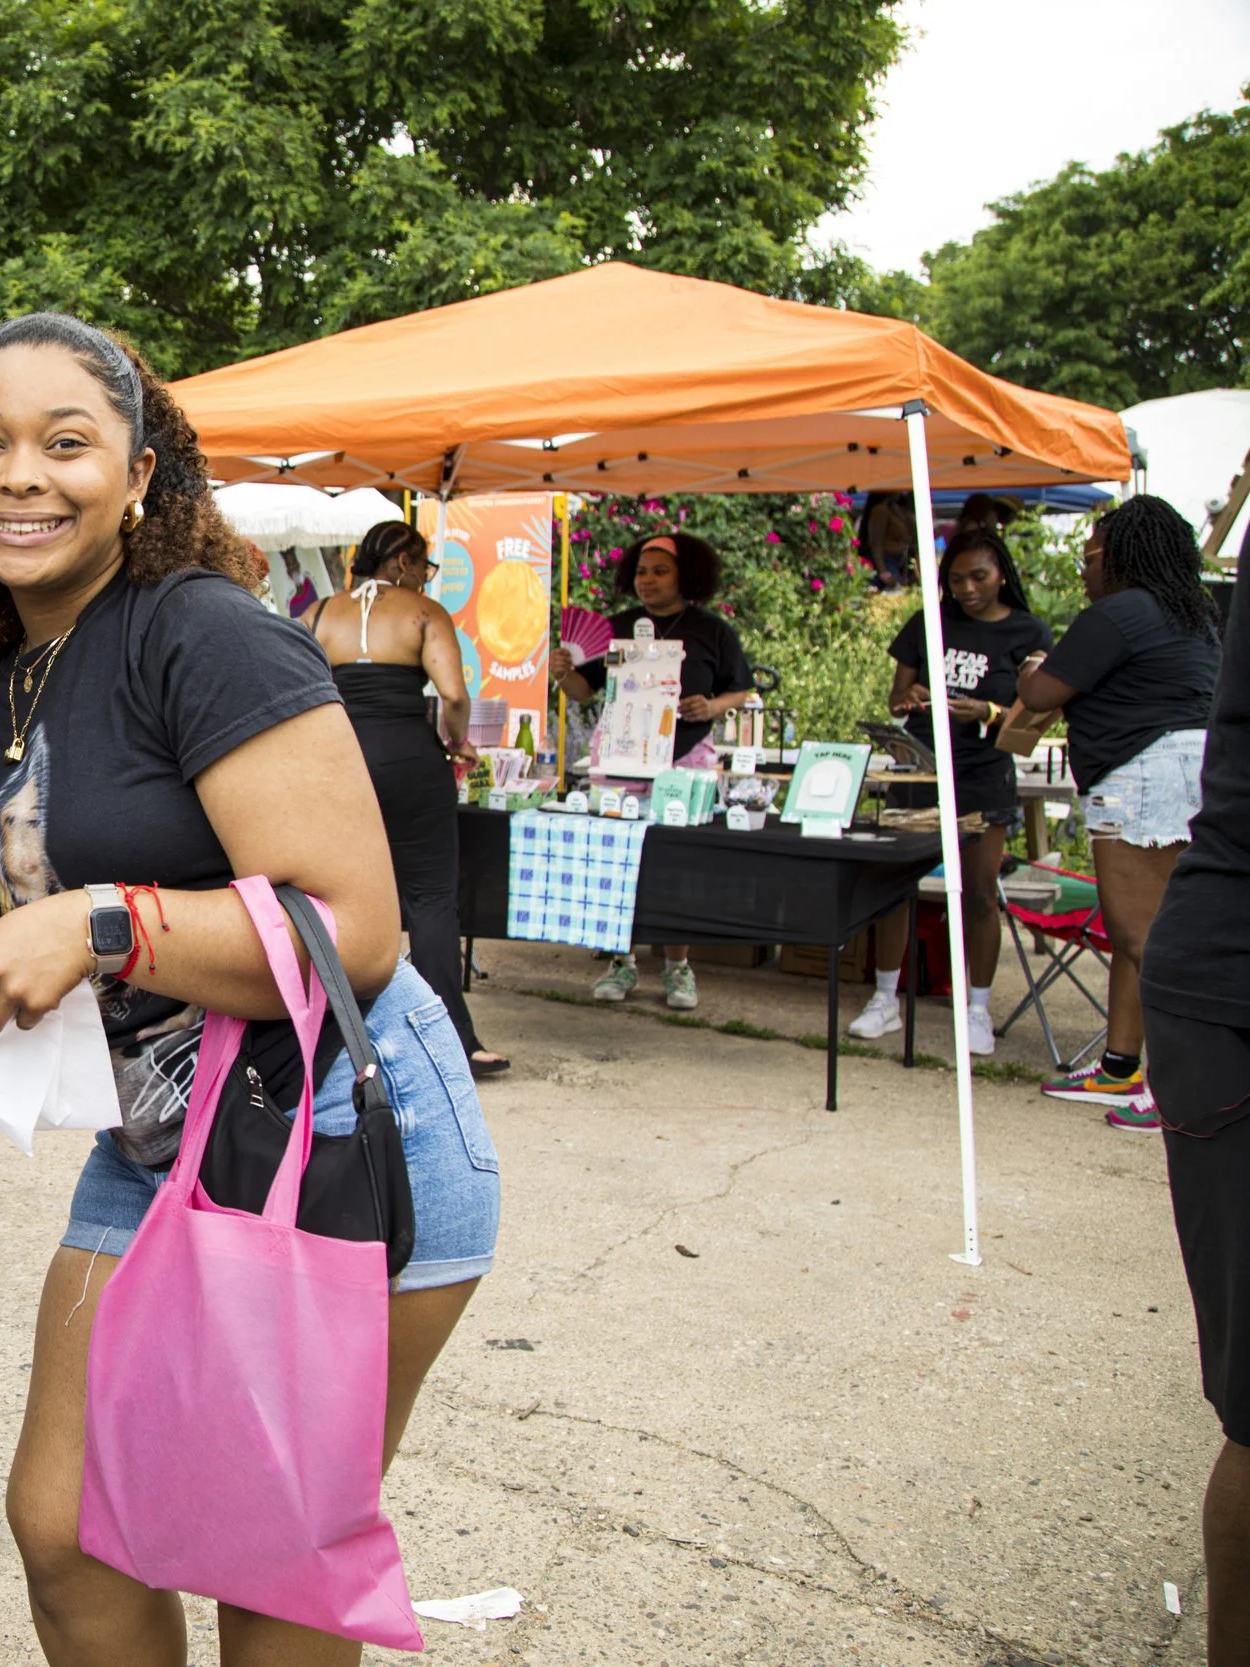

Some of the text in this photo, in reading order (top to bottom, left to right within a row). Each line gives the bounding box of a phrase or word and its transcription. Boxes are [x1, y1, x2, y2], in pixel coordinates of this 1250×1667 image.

[496, 536, 530, 560] FREE
[944, 647, 988, 666] READ
[489, 660, 535, 682] SAMPLES
[946, 673, 979, 690] EAD
[832, 751, 852, 760] HERE
